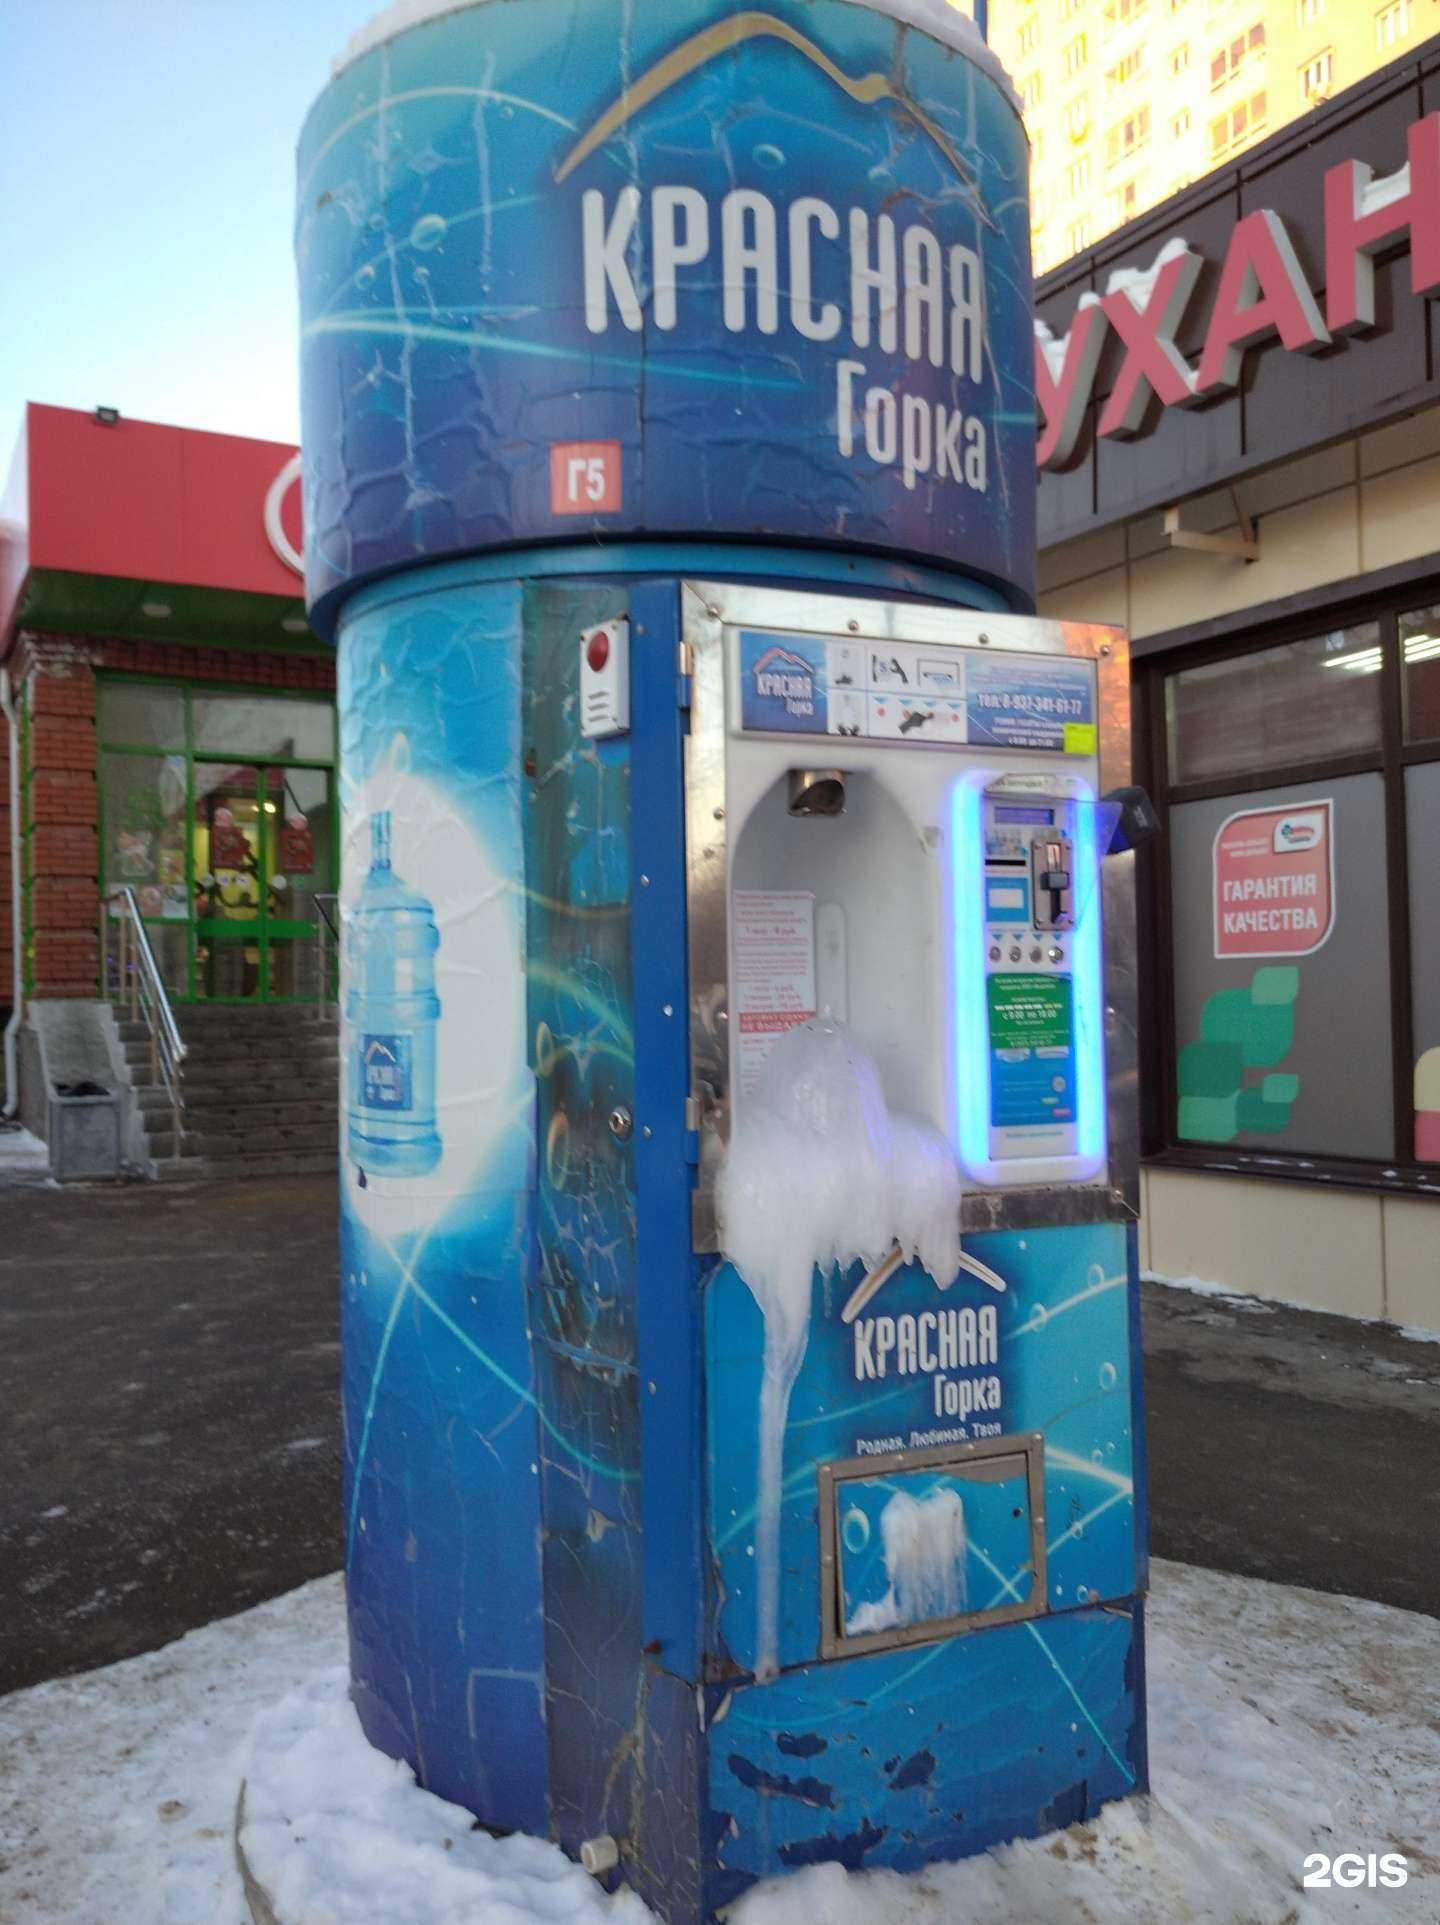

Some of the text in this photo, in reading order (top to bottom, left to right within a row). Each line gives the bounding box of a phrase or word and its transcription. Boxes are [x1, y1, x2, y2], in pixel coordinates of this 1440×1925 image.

[581, 185, 983, 384] КРАСНАЯ
[836, 359, 987, 493] Горка
[567, 458, 606, 501] Г5
[1223, 874, 1317, 902] ГАРАНТИЯ
[1224, 907, 1318, 934] КАЧЕСТВА
[854, 1305, 998, 1381] КРАСНАЯ
[934, 1374, 1001, 1421] Горка
